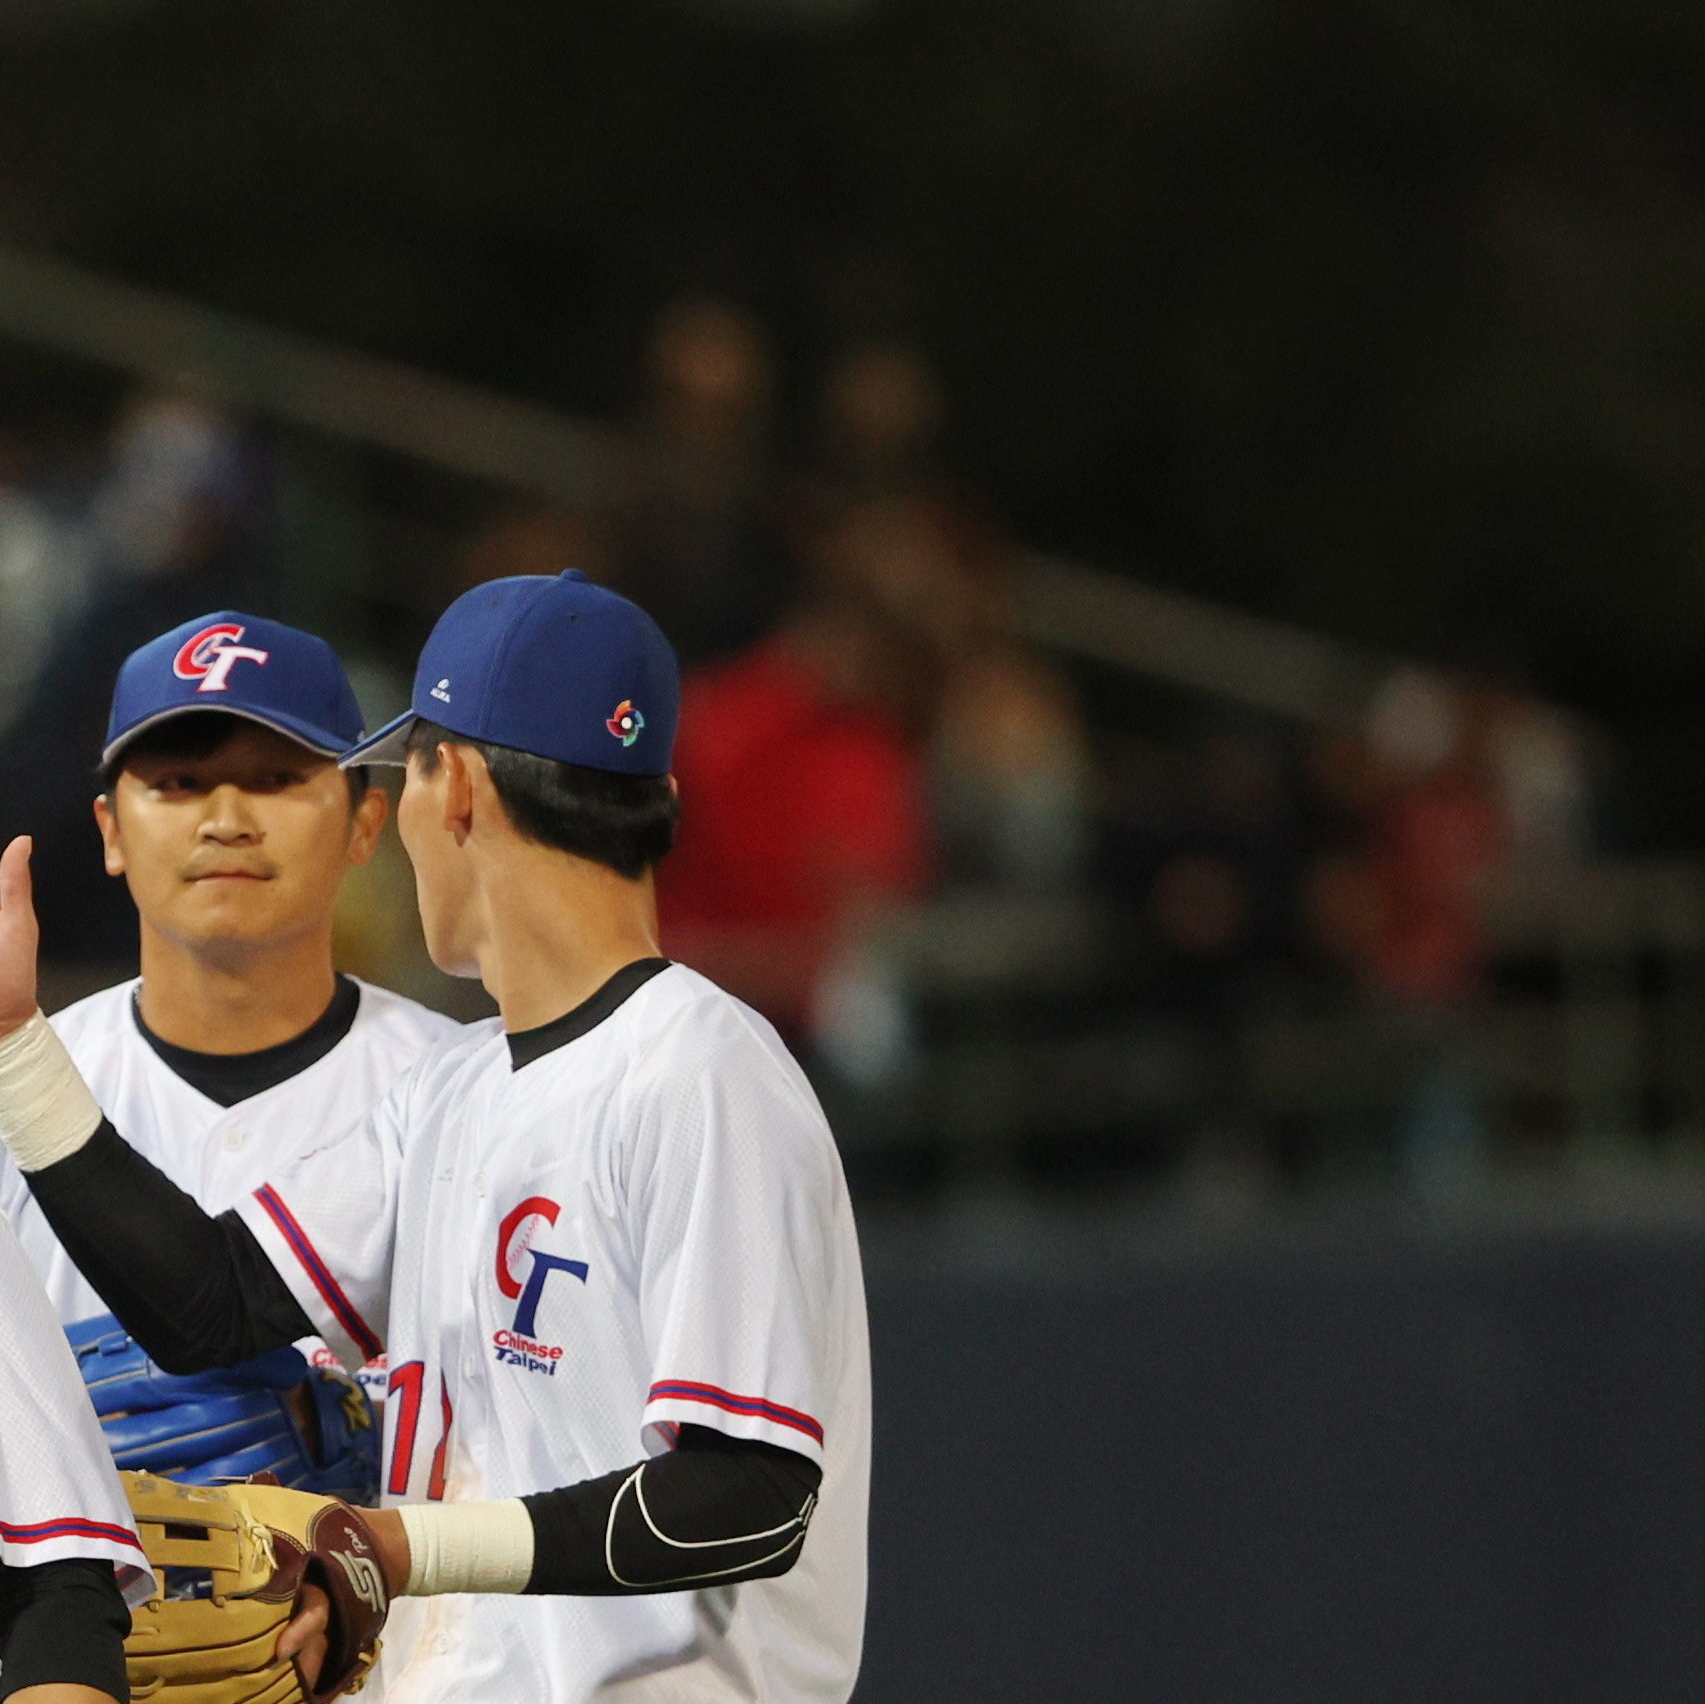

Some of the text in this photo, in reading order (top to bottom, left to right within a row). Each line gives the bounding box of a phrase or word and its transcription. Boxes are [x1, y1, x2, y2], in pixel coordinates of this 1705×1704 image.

[173, 623, 271, 693] CT
[496, 1195, 590, 1340] CT
[493, 1328, 564, 1360] Chinese
[493, 1345, 558, 1376] Taipei
